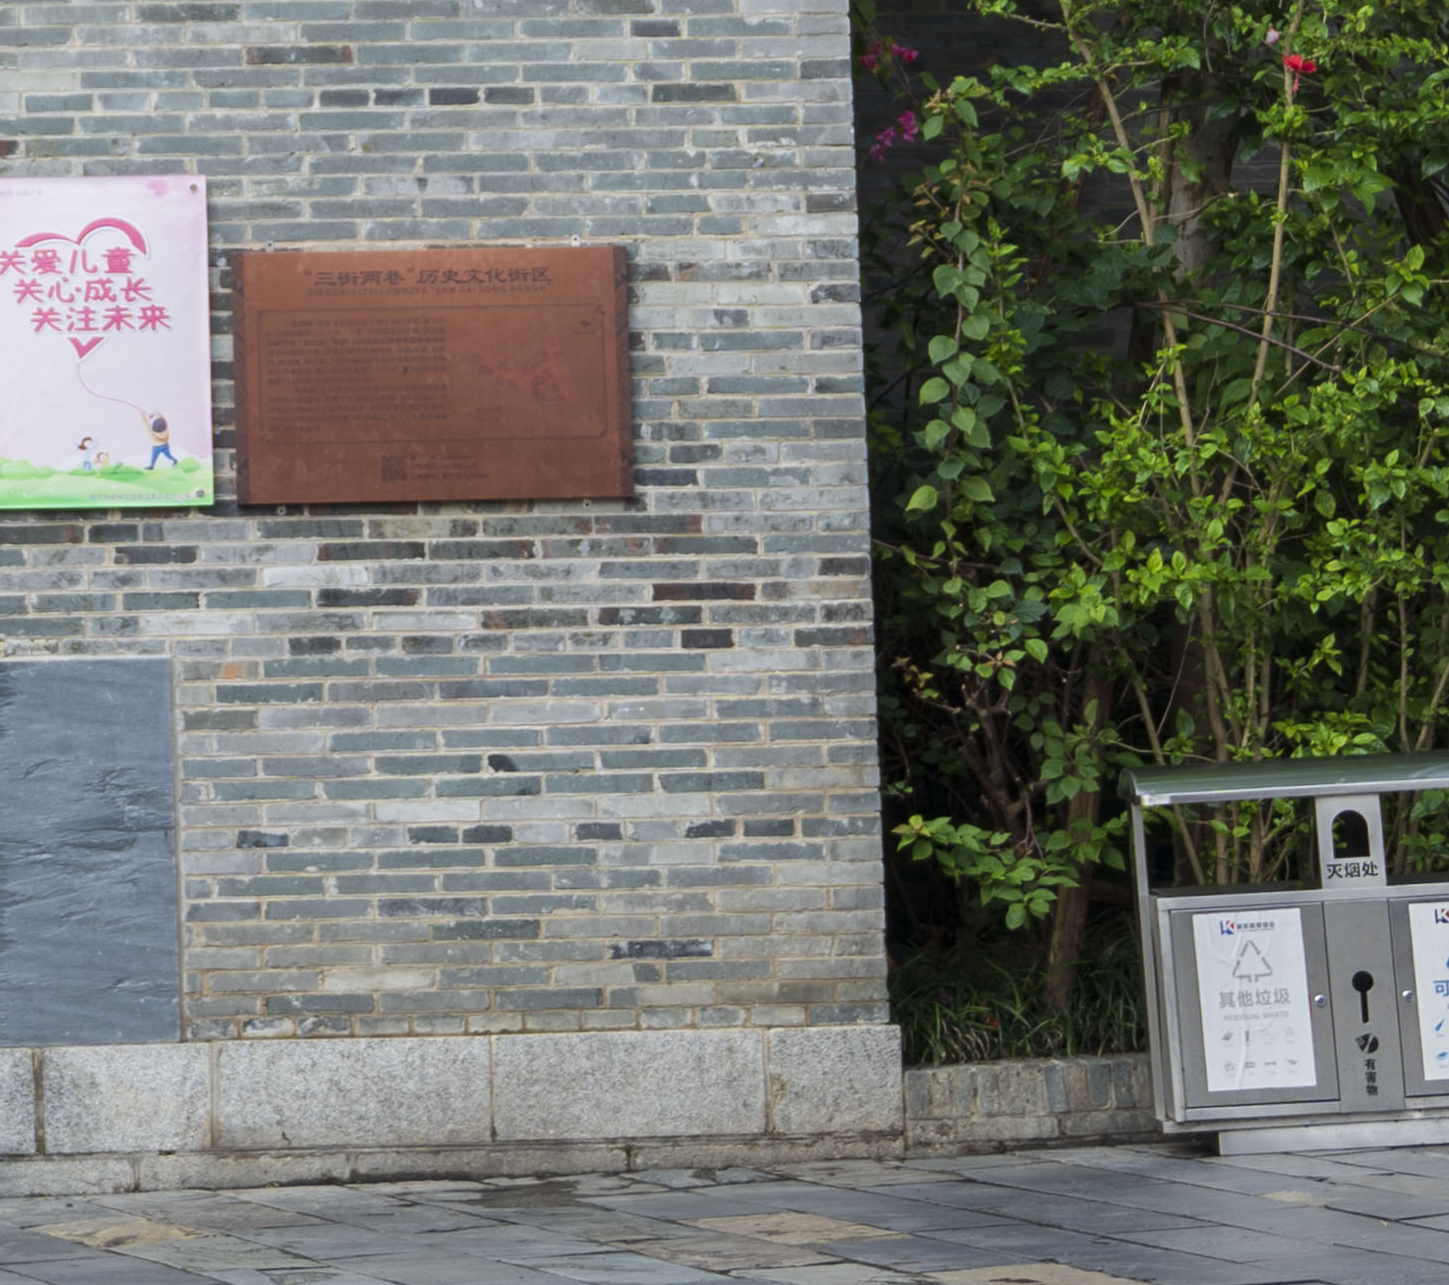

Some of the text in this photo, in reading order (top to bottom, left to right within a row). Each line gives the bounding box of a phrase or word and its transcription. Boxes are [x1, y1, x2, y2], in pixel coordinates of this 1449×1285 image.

[12, 276, 152, 305] 关心成长
[30, 303, 173, 333] 关注未来
[1325, 860, 1379, 879] 灭烟处
[1218, 987, 1291, 1009] 其他垃圾
[1262, 1011, 1290, 1020] WASTE
[1363, 1058, 1379, 1096] 有害物
